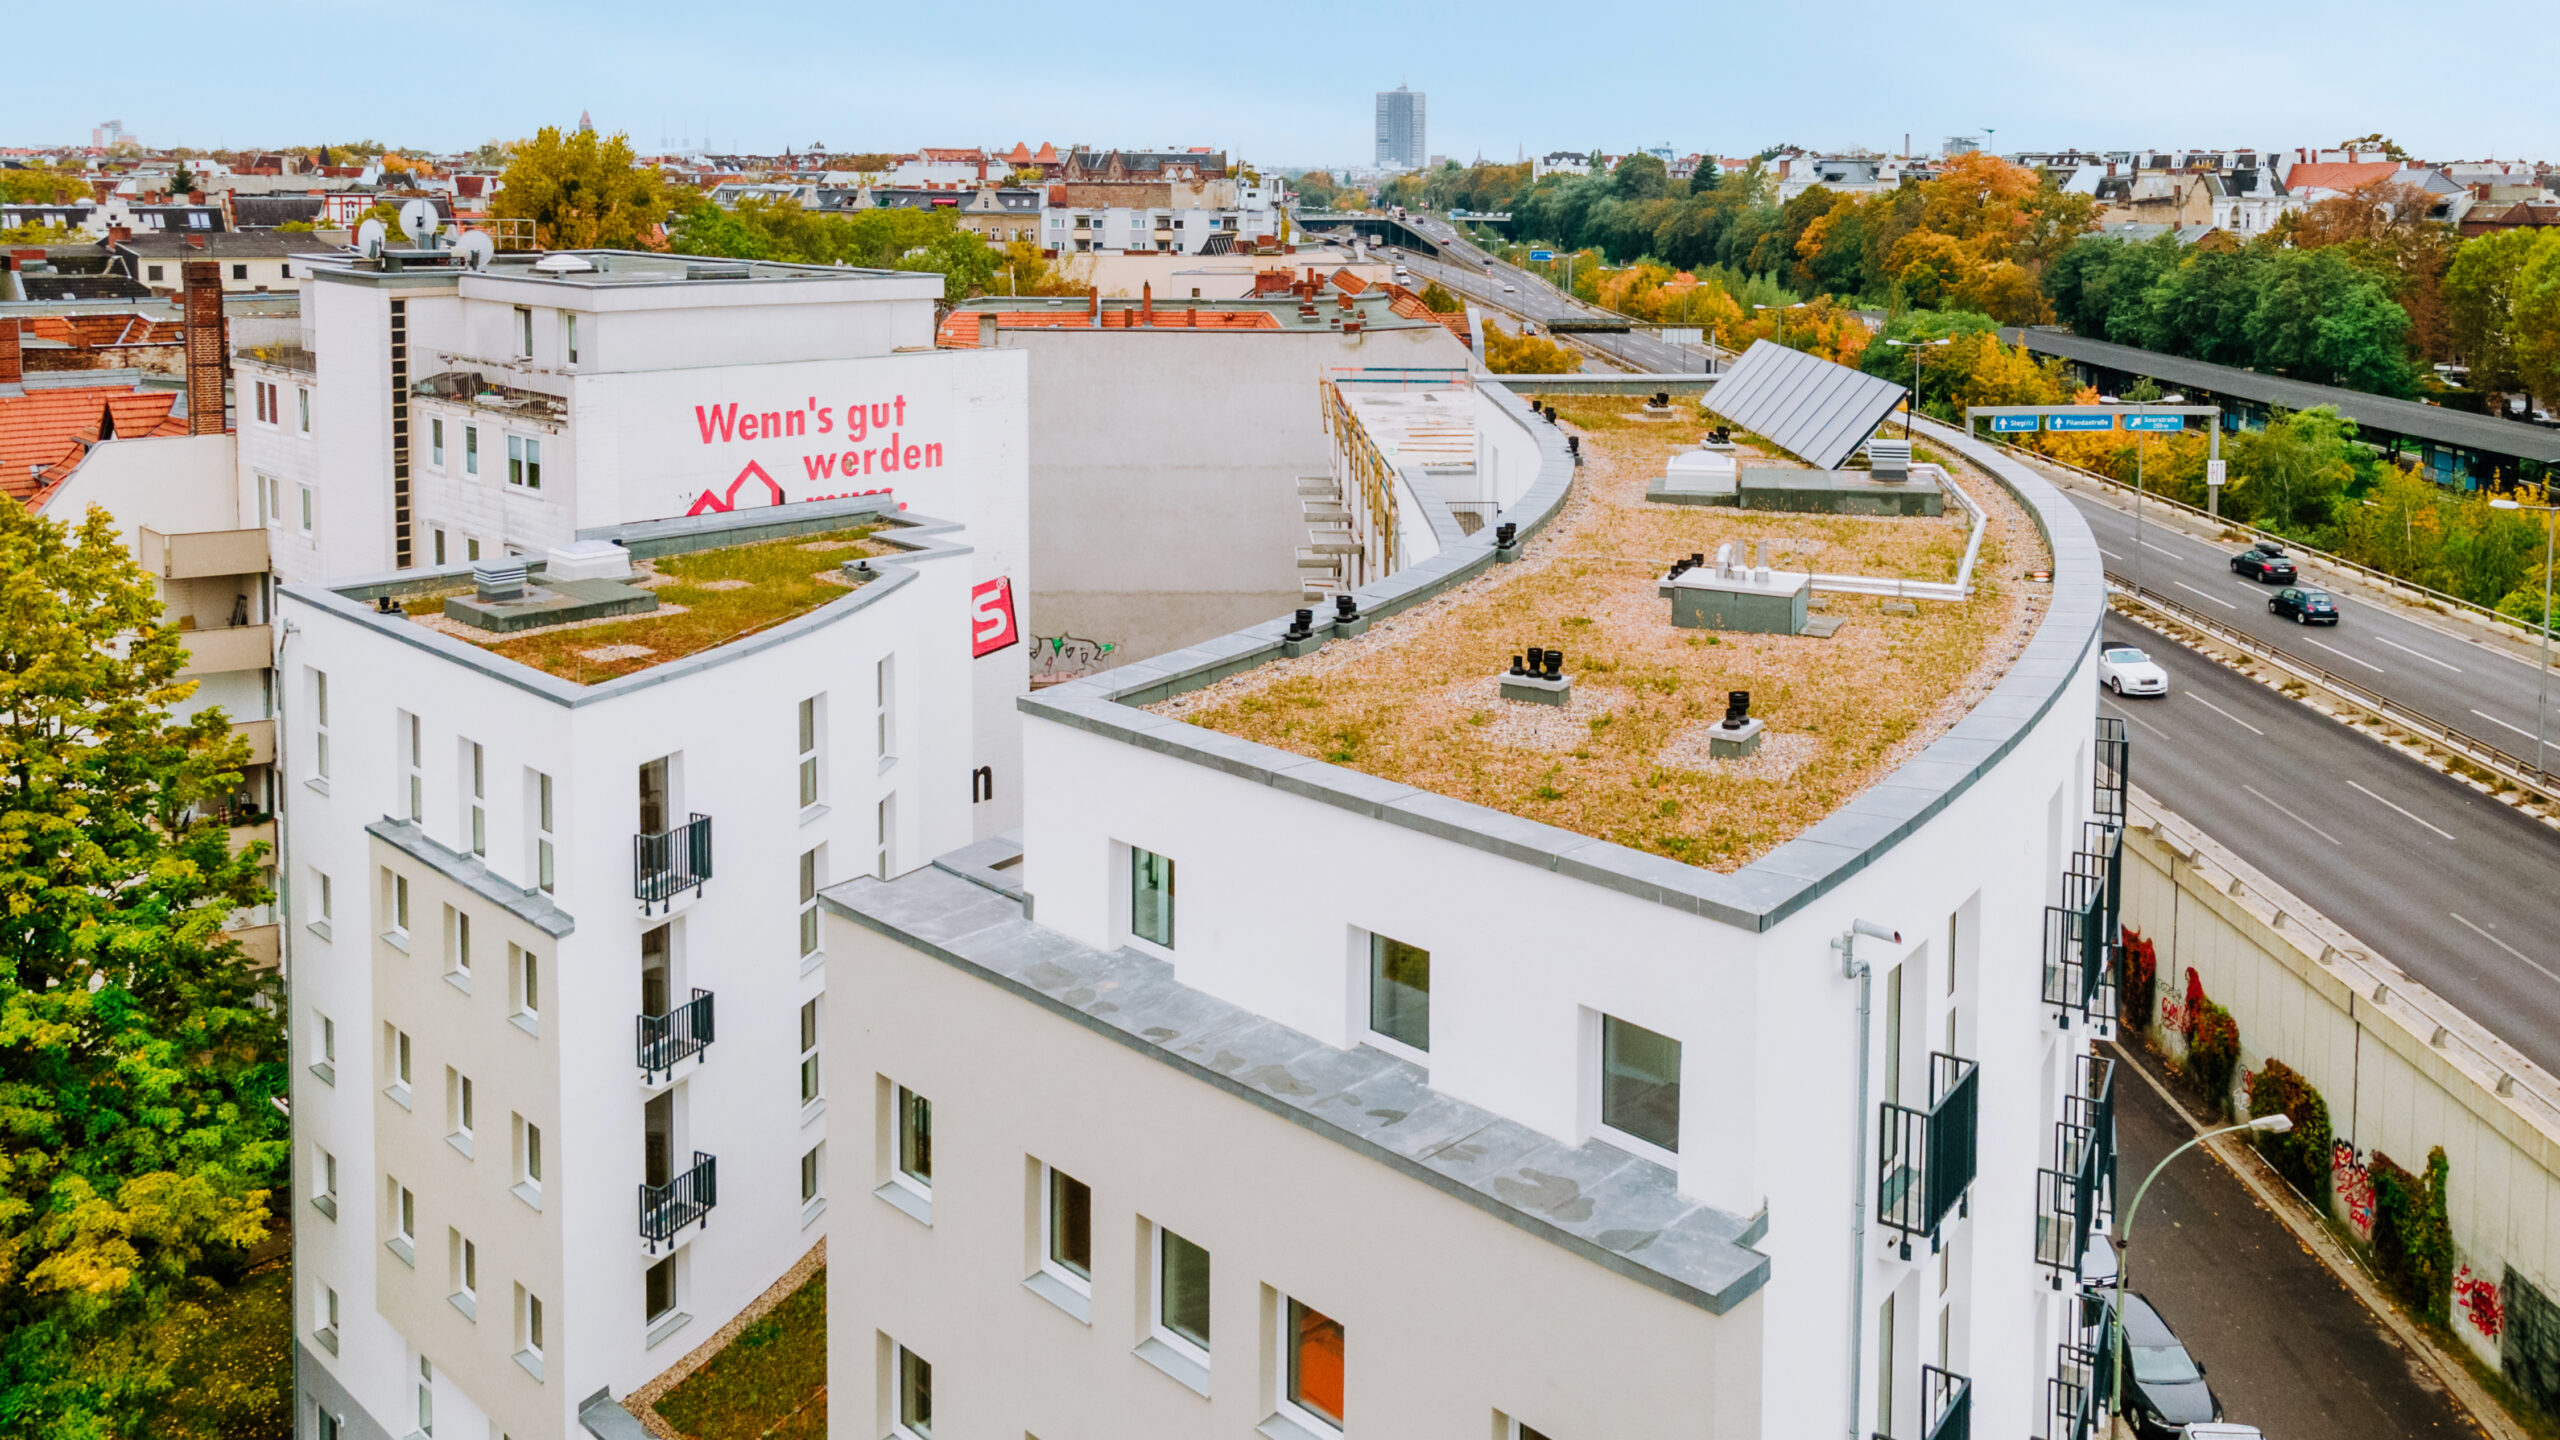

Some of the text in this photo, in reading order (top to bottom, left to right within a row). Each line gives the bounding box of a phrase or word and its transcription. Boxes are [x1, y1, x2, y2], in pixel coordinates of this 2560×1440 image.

[695, 395, 907, 445] Wenn's gut
[803, 433, 943, 481] werden
